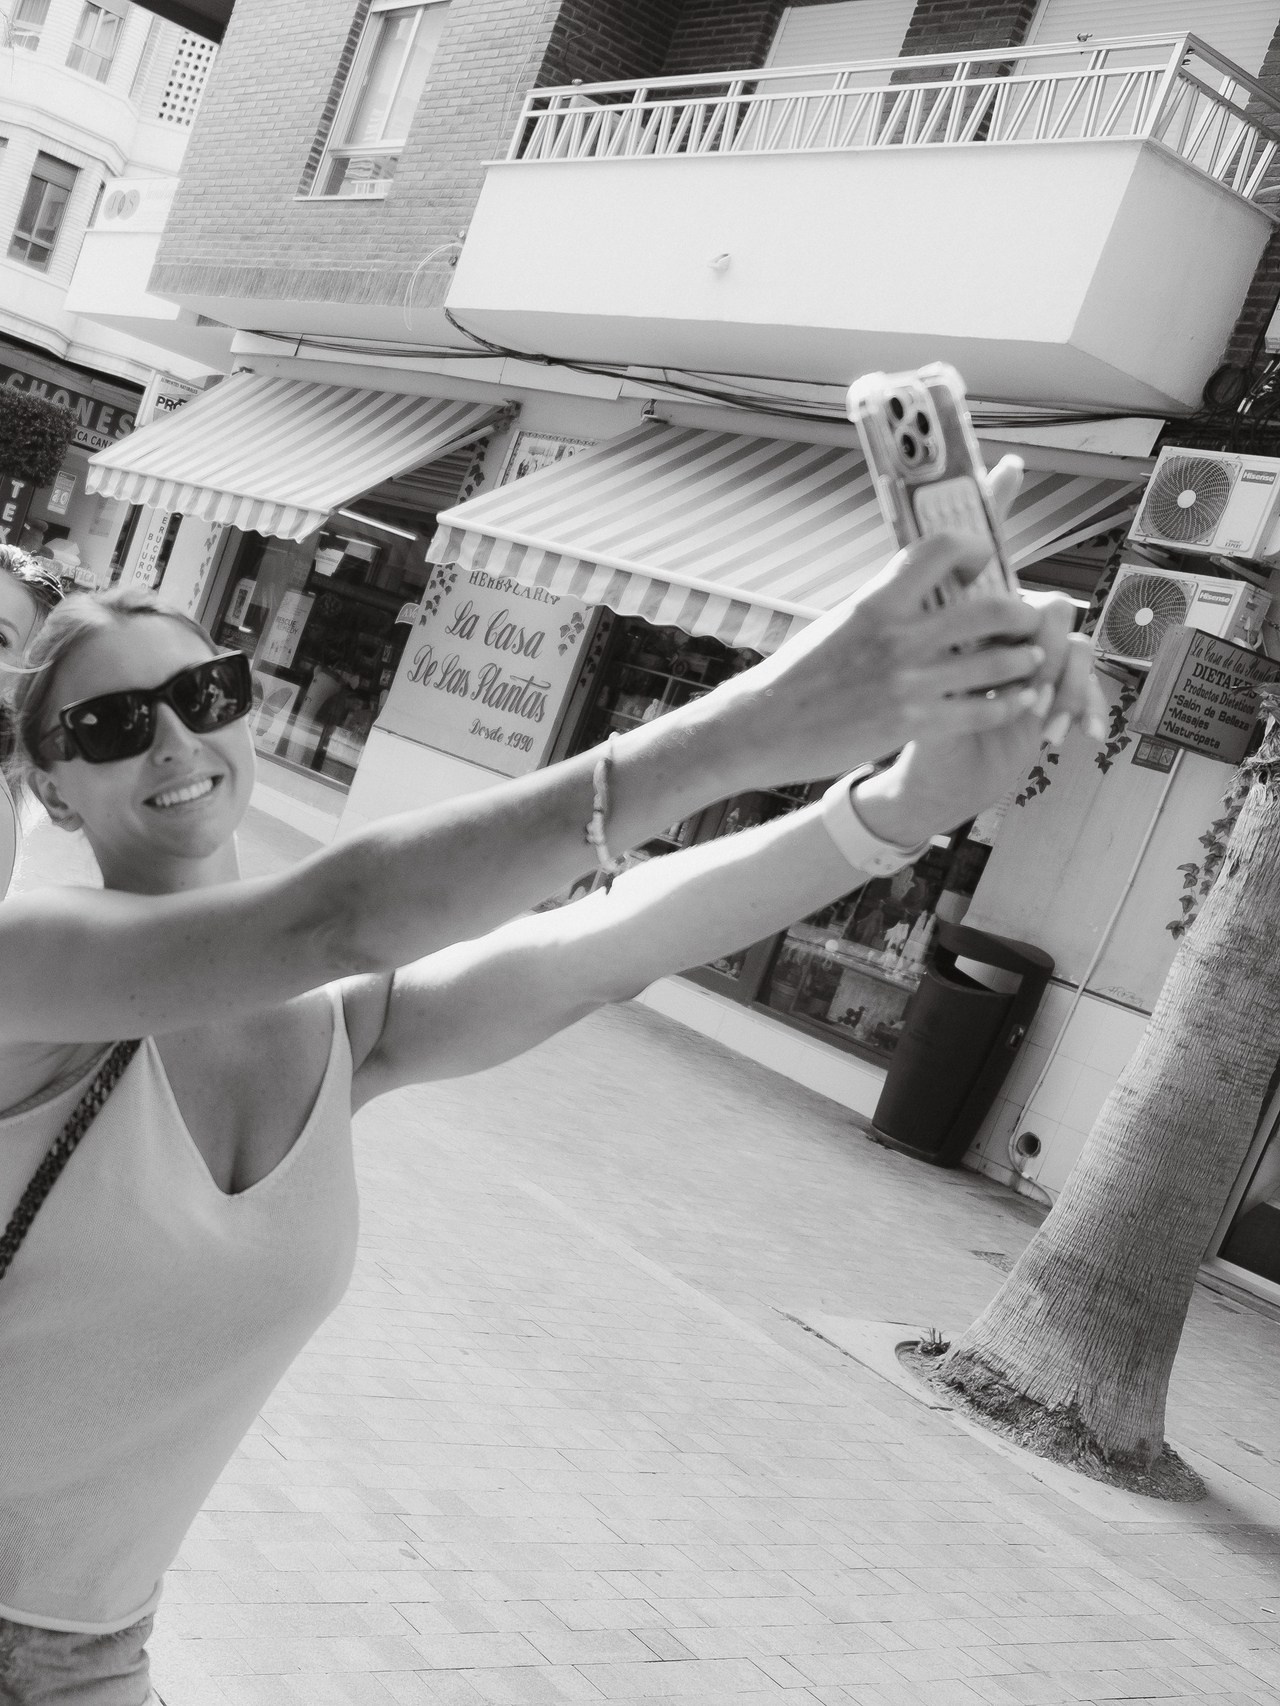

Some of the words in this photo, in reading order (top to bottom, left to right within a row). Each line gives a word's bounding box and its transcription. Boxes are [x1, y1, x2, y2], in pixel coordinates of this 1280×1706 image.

[1243, 471, 1275, 483] Hisense
[136, 532, 153, 579] BIURO
[1199, 592, 1231, 603] Hisense
[445, 600, 480, 641] La
[483, 608, 546, 660] Casa
[1190, 635, 1205, 660] La
[1204, 639, 1223, 666] Casa
[1222, 649, 1235, 670] de
[1234, 652, 1246, 674] las
[407, 644, 439, 687] De
[434, 652, 471, 698] Las
[470, 662, 552, 723] Plantas
[1182, 678, 1220, 704] Productos
[469, 718, 505, 743] Desde
[506, 730, 534, 752] 1990
[1204, 705, 1216, 719] de
[1218, 709, 1250, 732] Belleza
